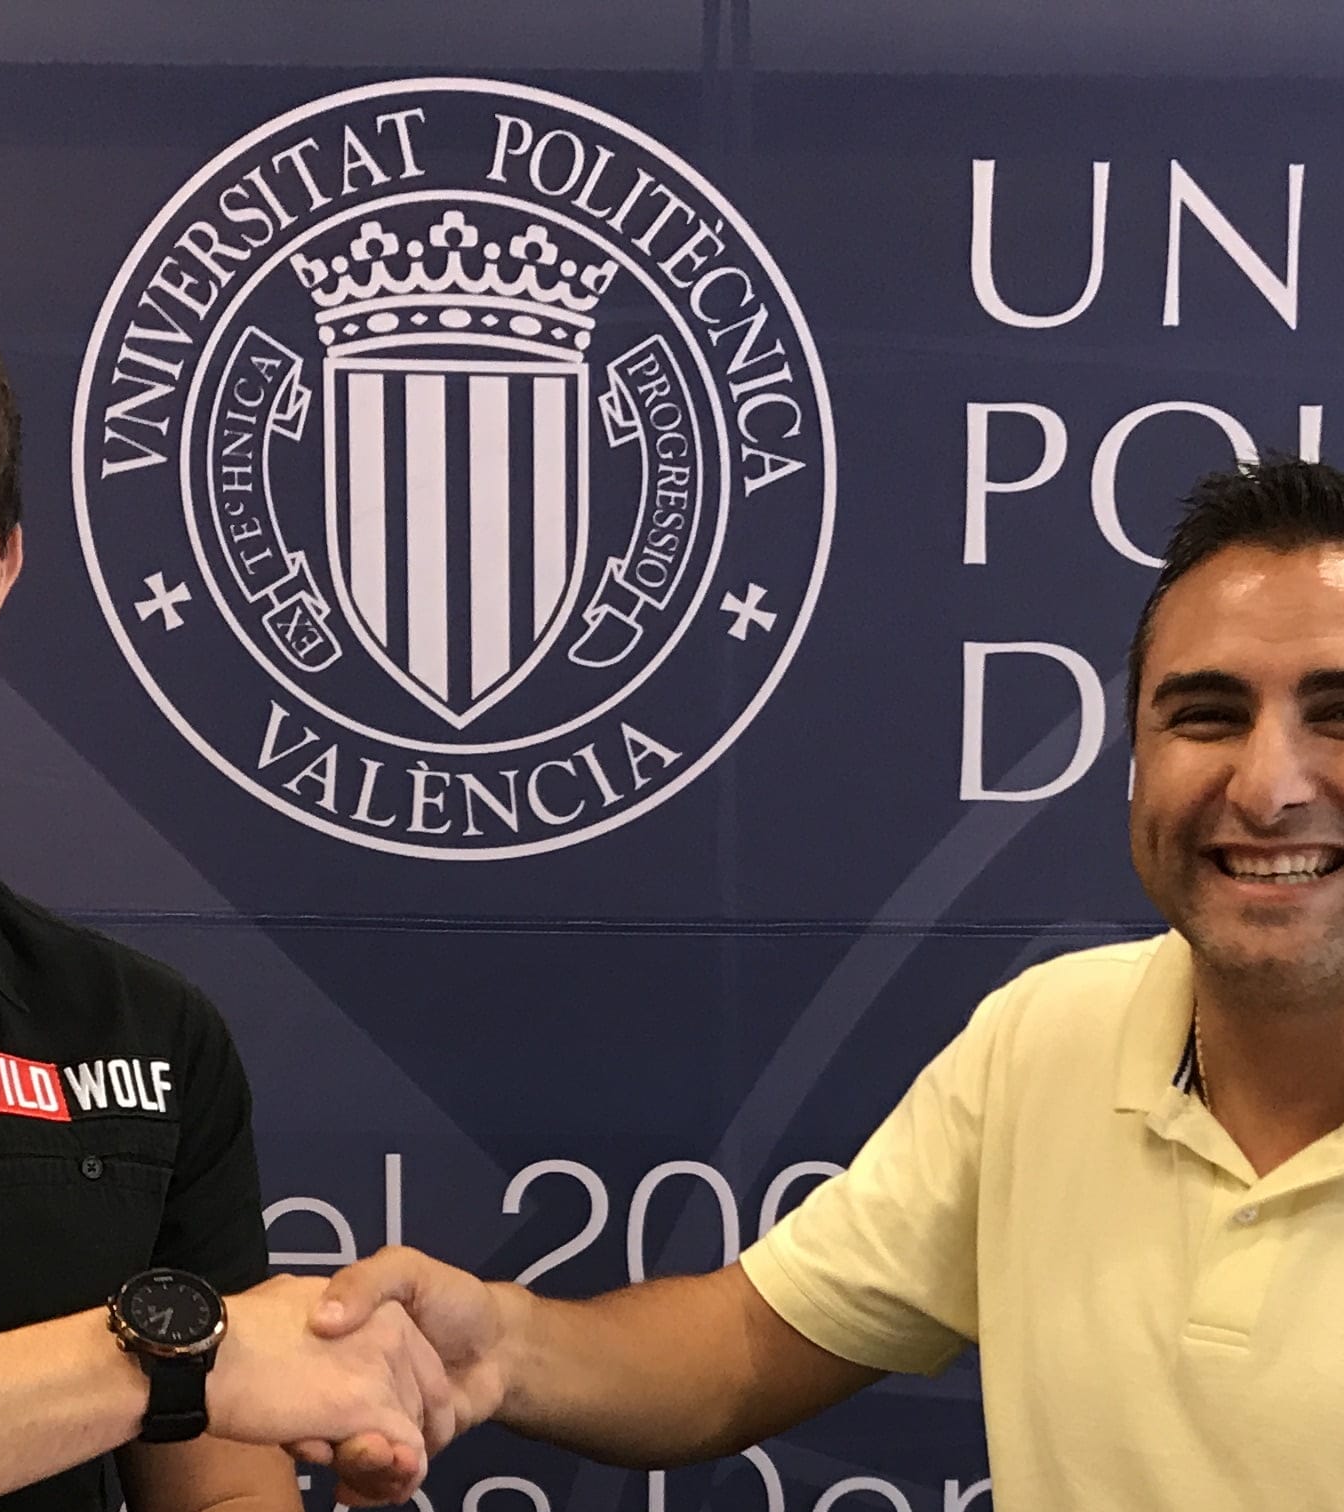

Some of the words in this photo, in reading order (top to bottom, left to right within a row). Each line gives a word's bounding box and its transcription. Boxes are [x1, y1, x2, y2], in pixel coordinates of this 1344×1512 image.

[487, 114, 806, 498] POLITÈCNICA
[627, 353, 690, 588] PROGRESSIO
[277, 606, 324, 659] EX
[256, 700, 682, 836] VALÈNCIA
[959, 641, 1135, 801] D
[63, 1059, 172, 1113] WOLF
